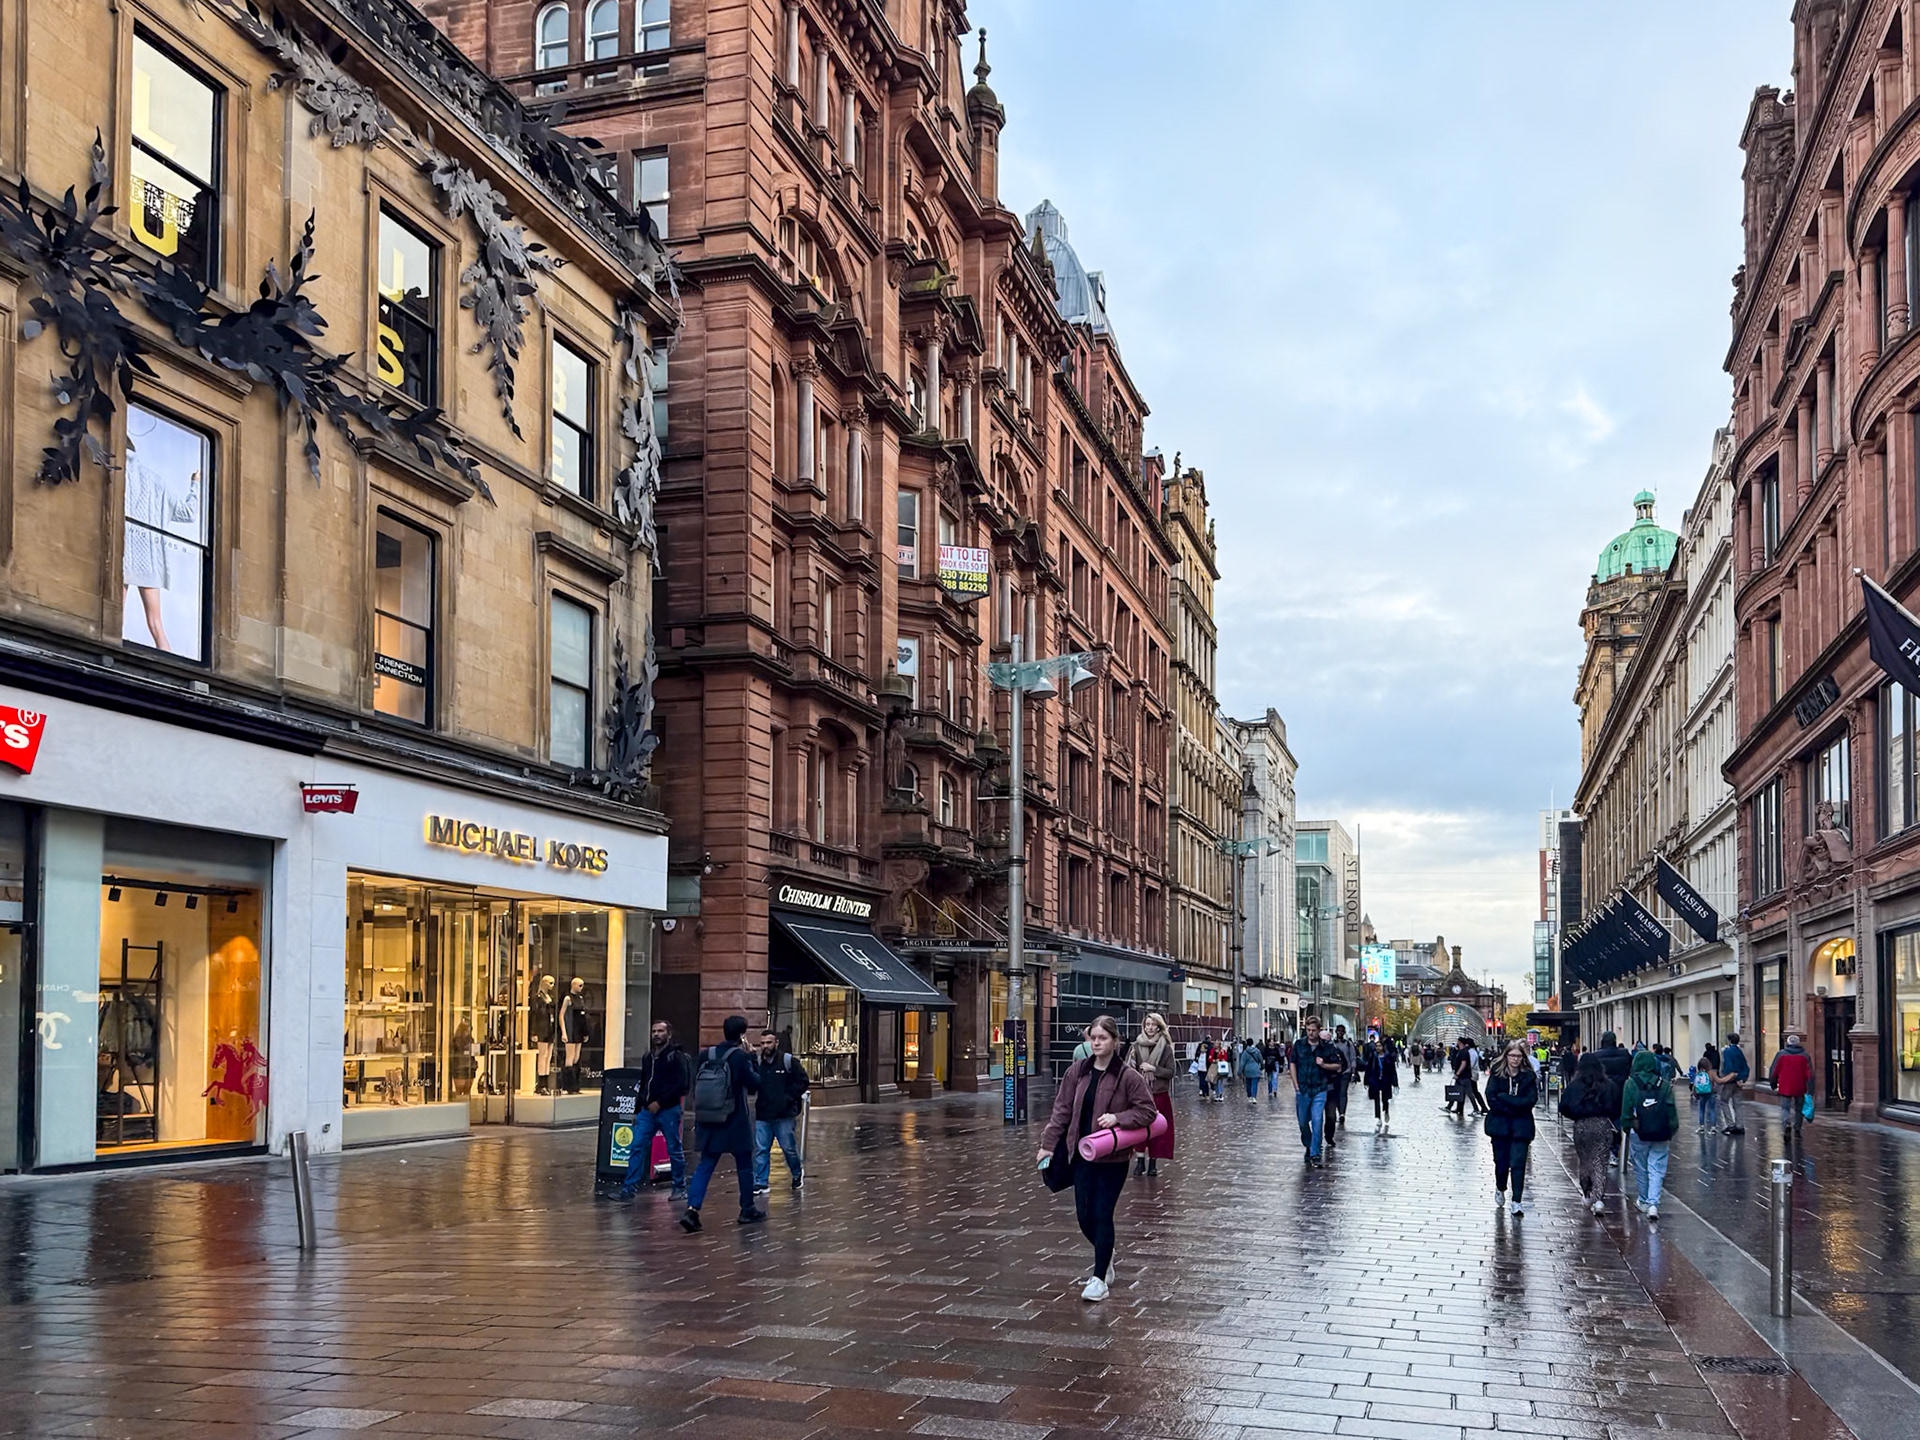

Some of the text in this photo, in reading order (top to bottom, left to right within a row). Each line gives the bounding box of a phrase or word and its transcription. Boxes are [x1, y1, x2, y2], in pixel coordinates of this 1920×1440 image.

[957, 549, 969, 560] TO
[972, 550, 987, 562] LET
[959, 571, 988, 583] 772888
[959, 581, 988, 593] 882290
[380, 656, 412, 672] FRENCH
[428, 815, 609, 873] MICHAEL KORS
[779, 885, 872, 918] CHISHOLM HUNTER
[1346, 860, 1358, 933] ST ENOCH
[1672, 883, 1709, 919] FRASERS
[1633, 909, 1664, 939] FRASERS
[607, 1106, 635, 1114] GLASGOW
[1005, 1076, 1015, 1119] BUSKING
